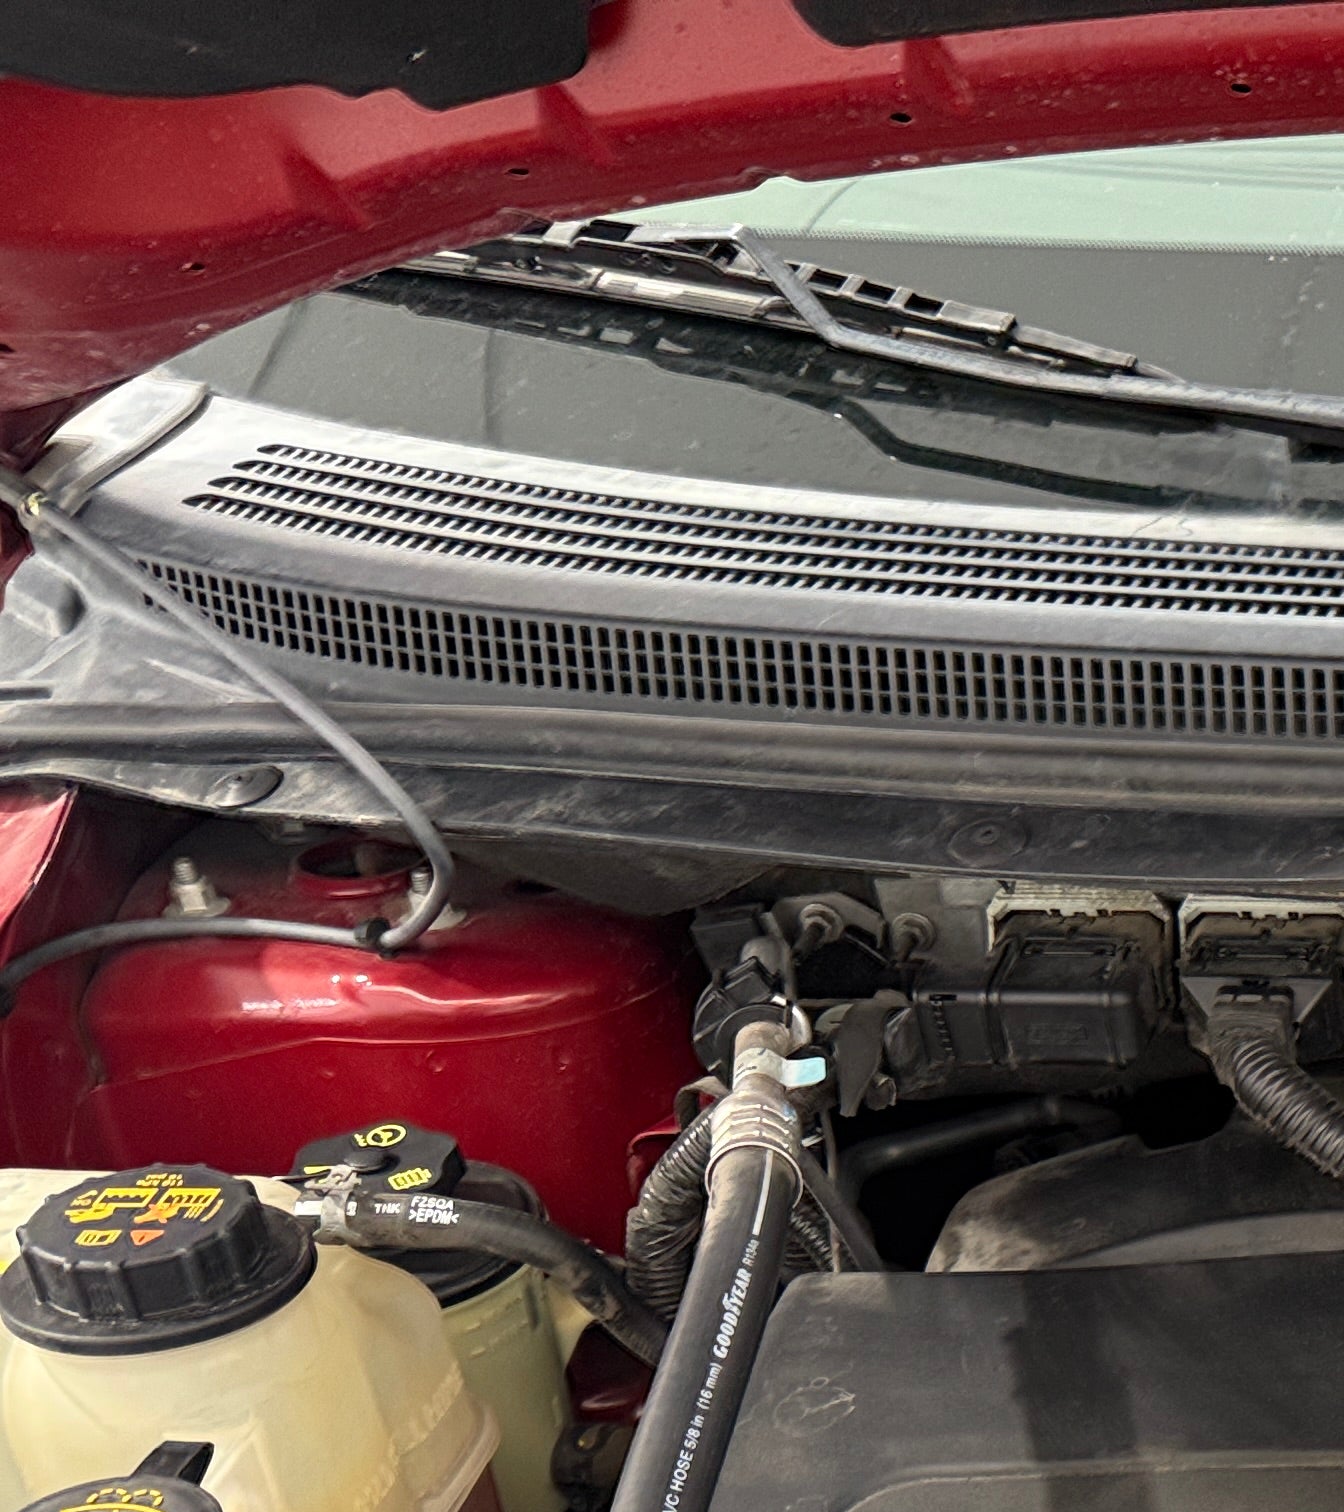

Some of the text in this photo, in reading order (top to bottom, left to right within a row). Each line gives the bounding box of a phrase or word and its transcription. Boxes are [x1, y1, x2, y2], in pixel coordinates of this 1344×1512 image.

[742, 1239, 760, 1267] R134a
[712, 1267, 752, 1360] GOODYEAR
[706, 1362, 724, 1388] mm)
[696, 1389, 713, 1411] (16
[690, 1414, 705, 1429] in
[684, 1427, 702, 1450] 5/8
[669, 1449, 694, 1493] HOSE
